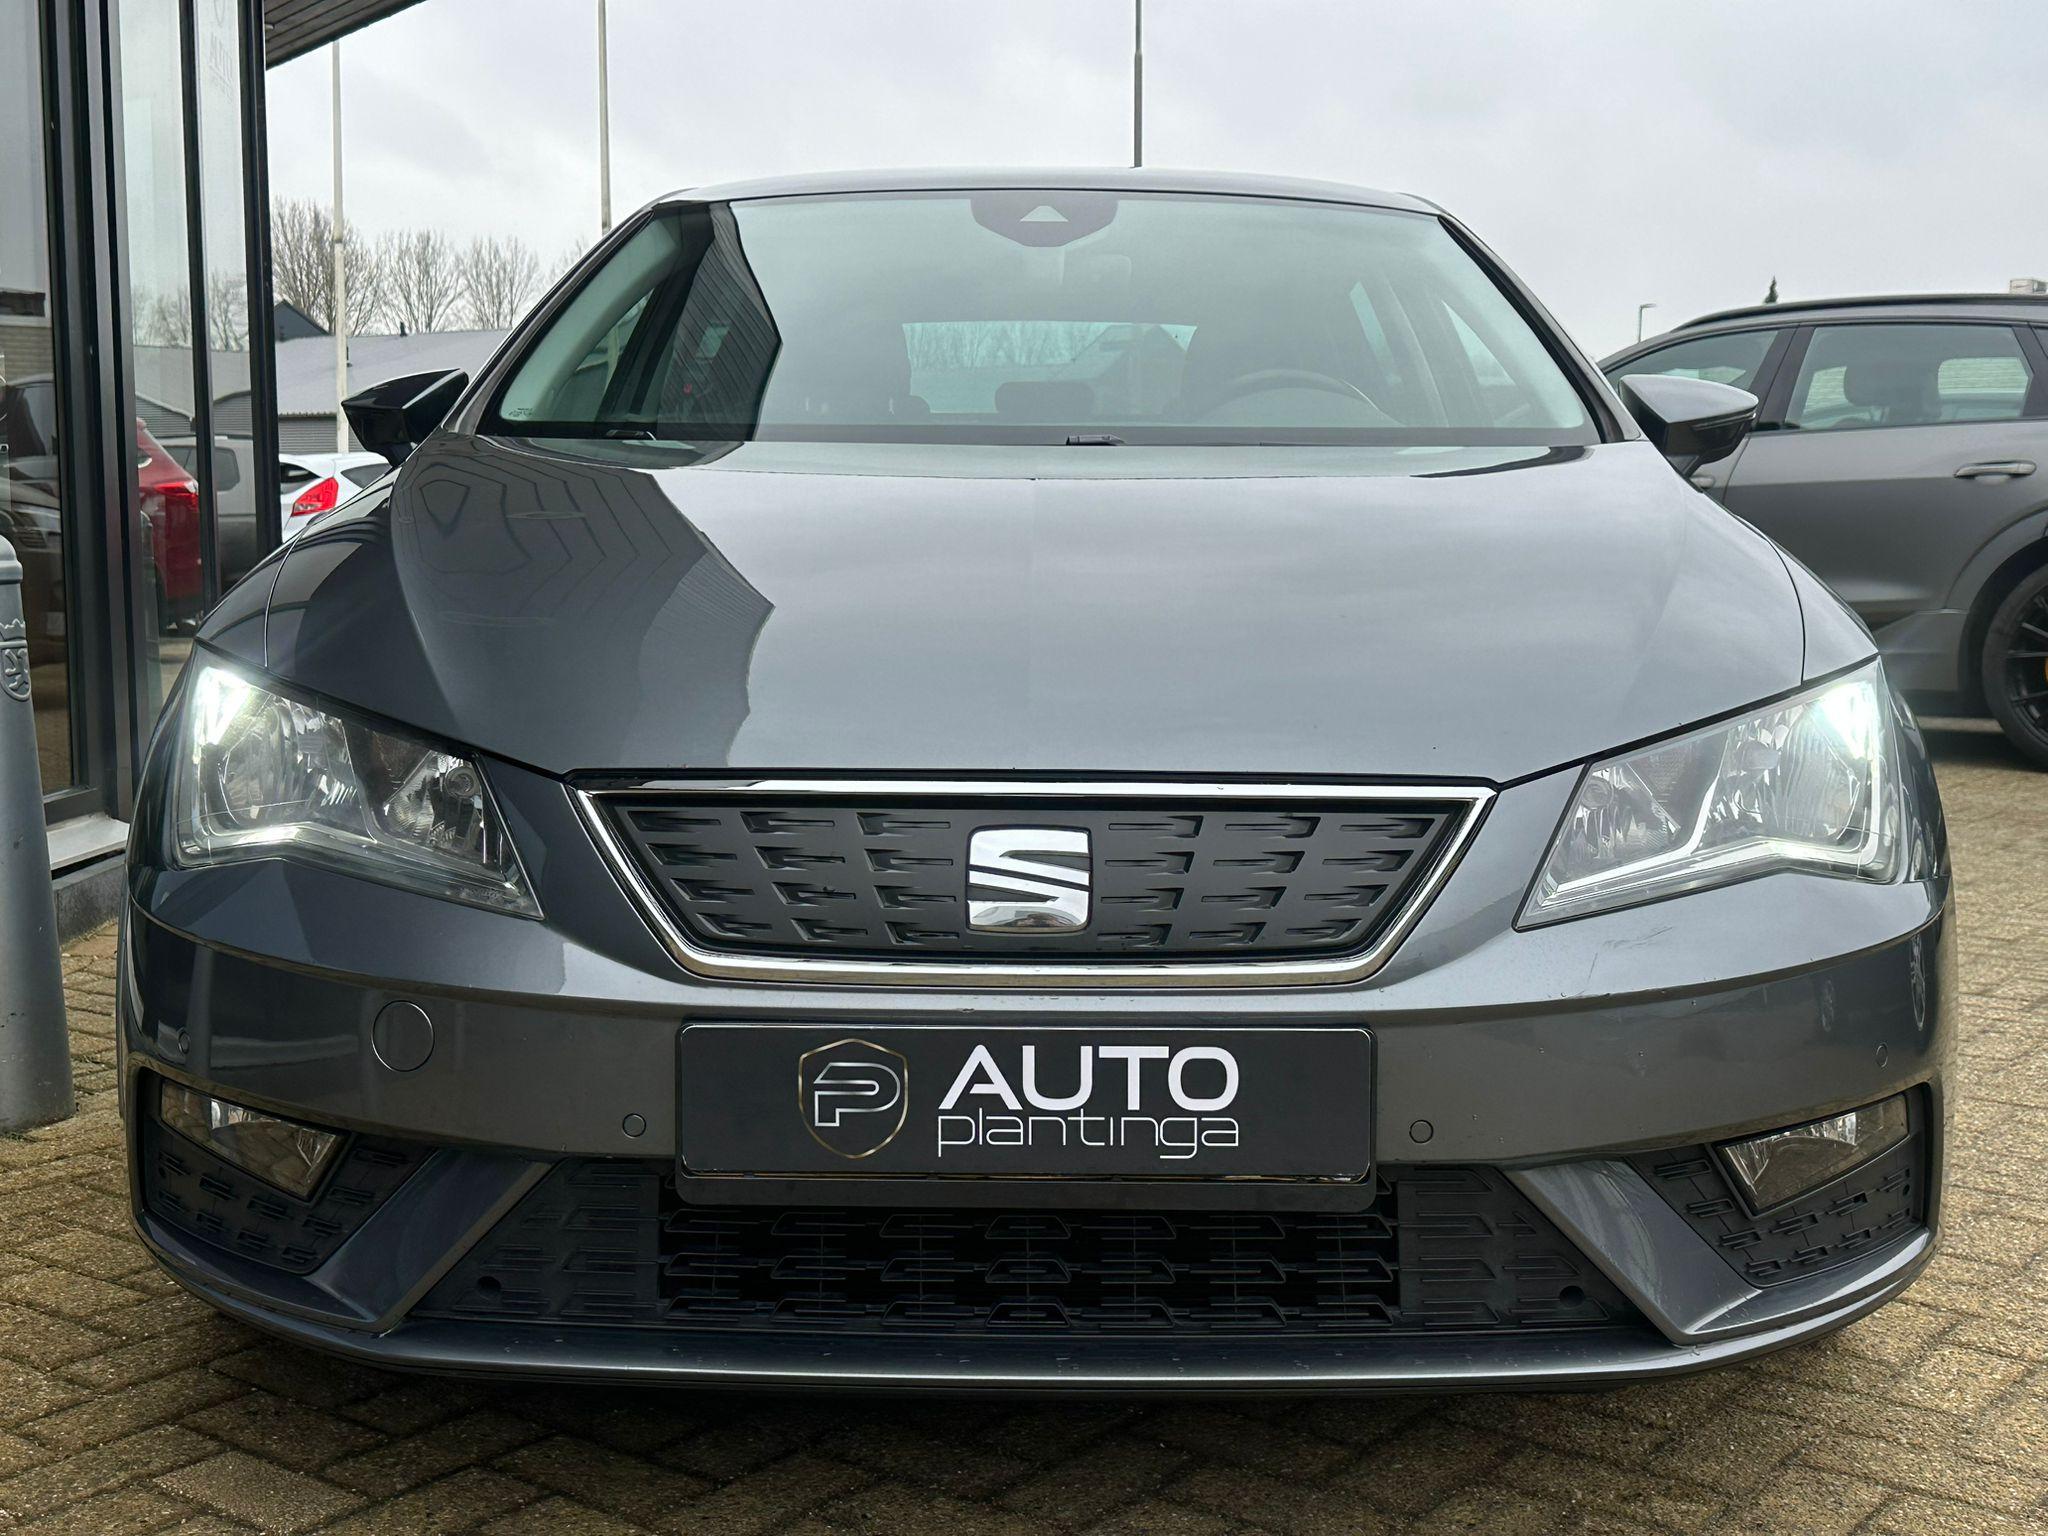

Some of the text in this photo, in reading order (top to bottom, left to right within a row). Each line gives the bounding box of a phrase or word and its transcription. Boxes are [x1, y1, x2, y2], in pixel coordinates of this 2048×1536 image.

[814, 1061, 900, 1127] P
[938, 1045, 1240, 1111] AUTO
[937, 1108, 1239, 1159] plantinga
